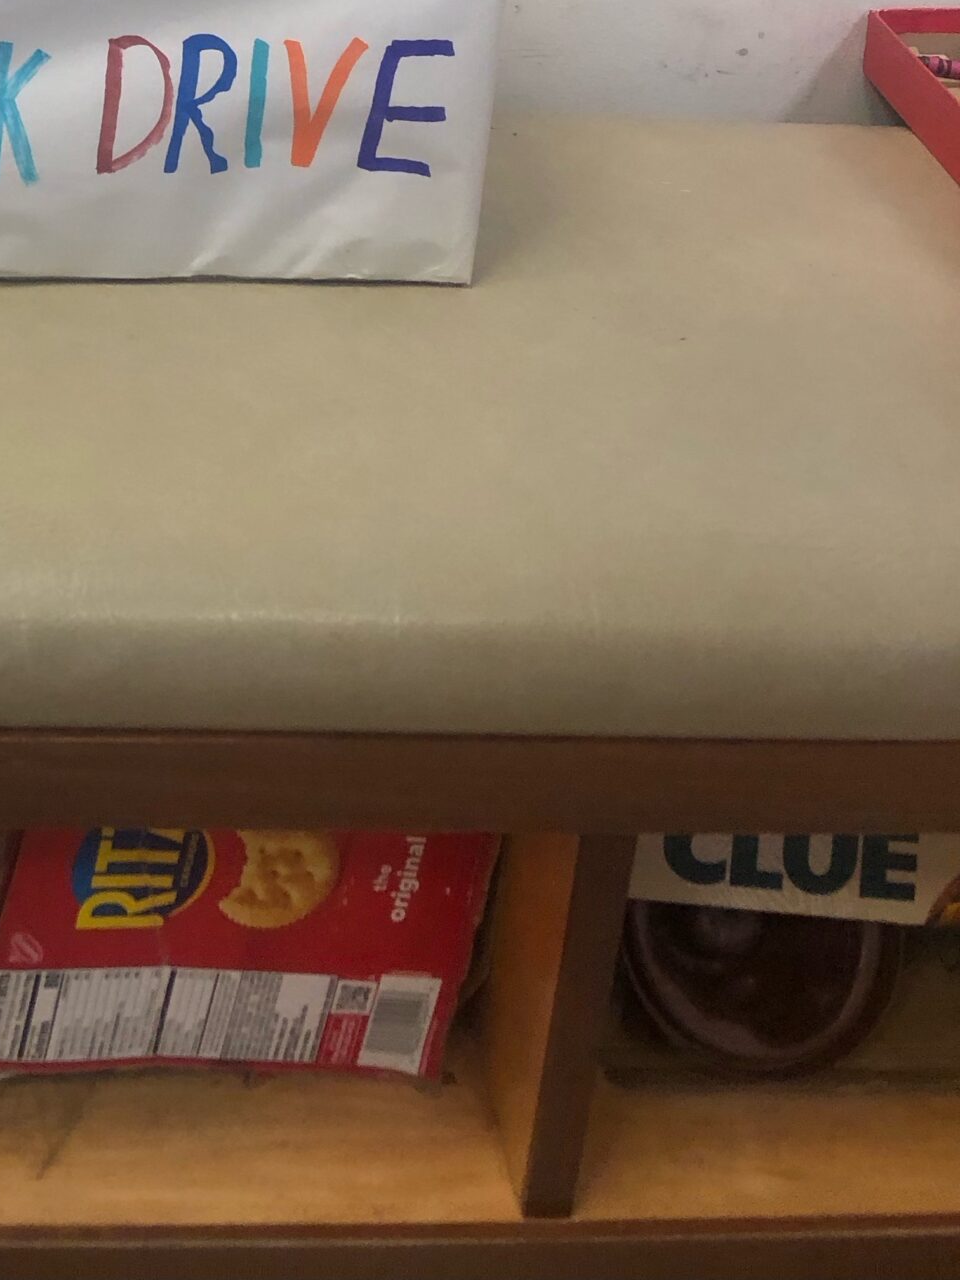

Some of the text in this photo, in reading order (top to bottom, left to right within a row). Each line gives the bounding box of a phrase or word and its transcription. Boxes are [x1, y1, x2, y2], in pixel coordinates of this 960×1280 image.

[95, 33, 456, 178] DRIVE
[390, 835, 427, 923] original
[663, 833, 920, 902] CLUE
